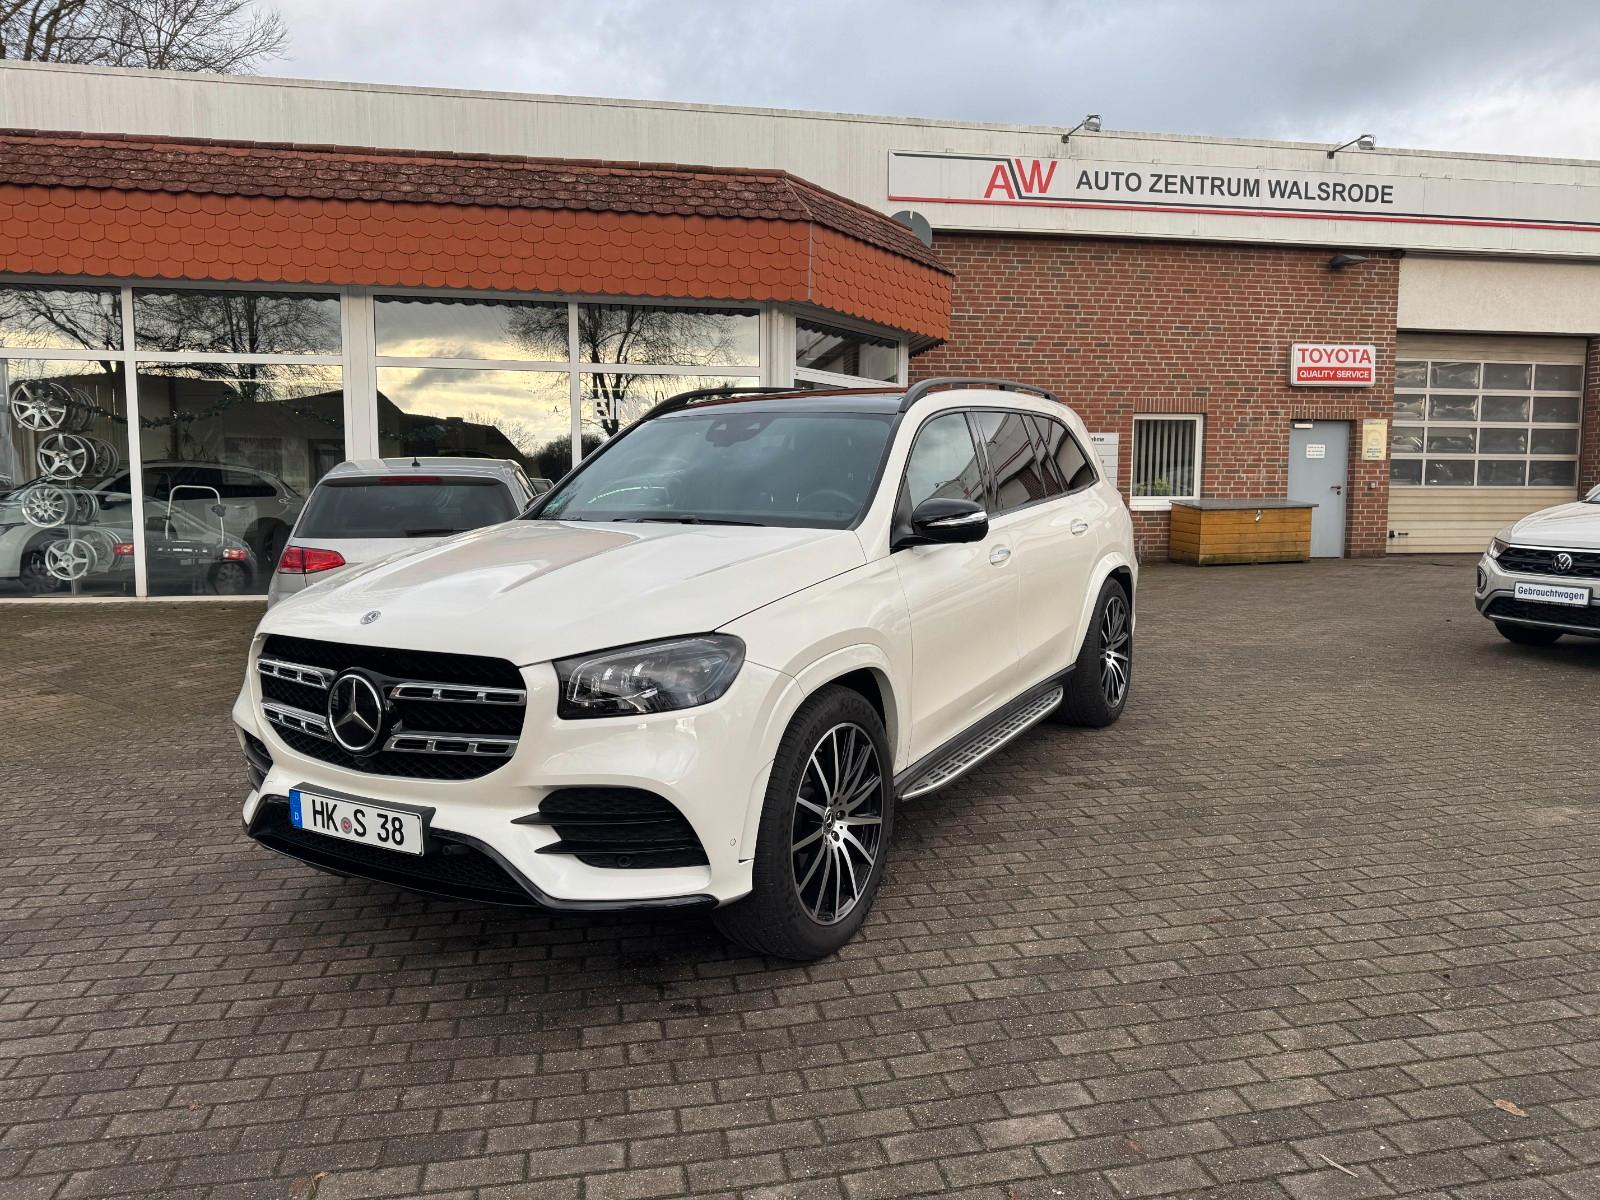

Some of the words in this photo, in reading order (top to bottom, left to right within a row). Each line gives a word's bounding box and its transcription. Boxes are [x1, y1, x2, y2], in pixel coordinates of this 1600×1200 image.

[1076, 169, 1142, 193] AUTO
[1149, 173, 1260, 198] ZENTRUM
[1268, 179, 1394, 204] WALSRODE
[1298, 348, 1372, 364] TOYOTA
[1300, 370, 1335, 379] QUALITY
[1336, 370, 1369, 379] SERVICE
[1518, 586, 1585, 601] Gebrauchtwagen
[312, 799, 339, 832] HK
[353, 808, 367, 838] S
[376, 813, 405, 846] 38
